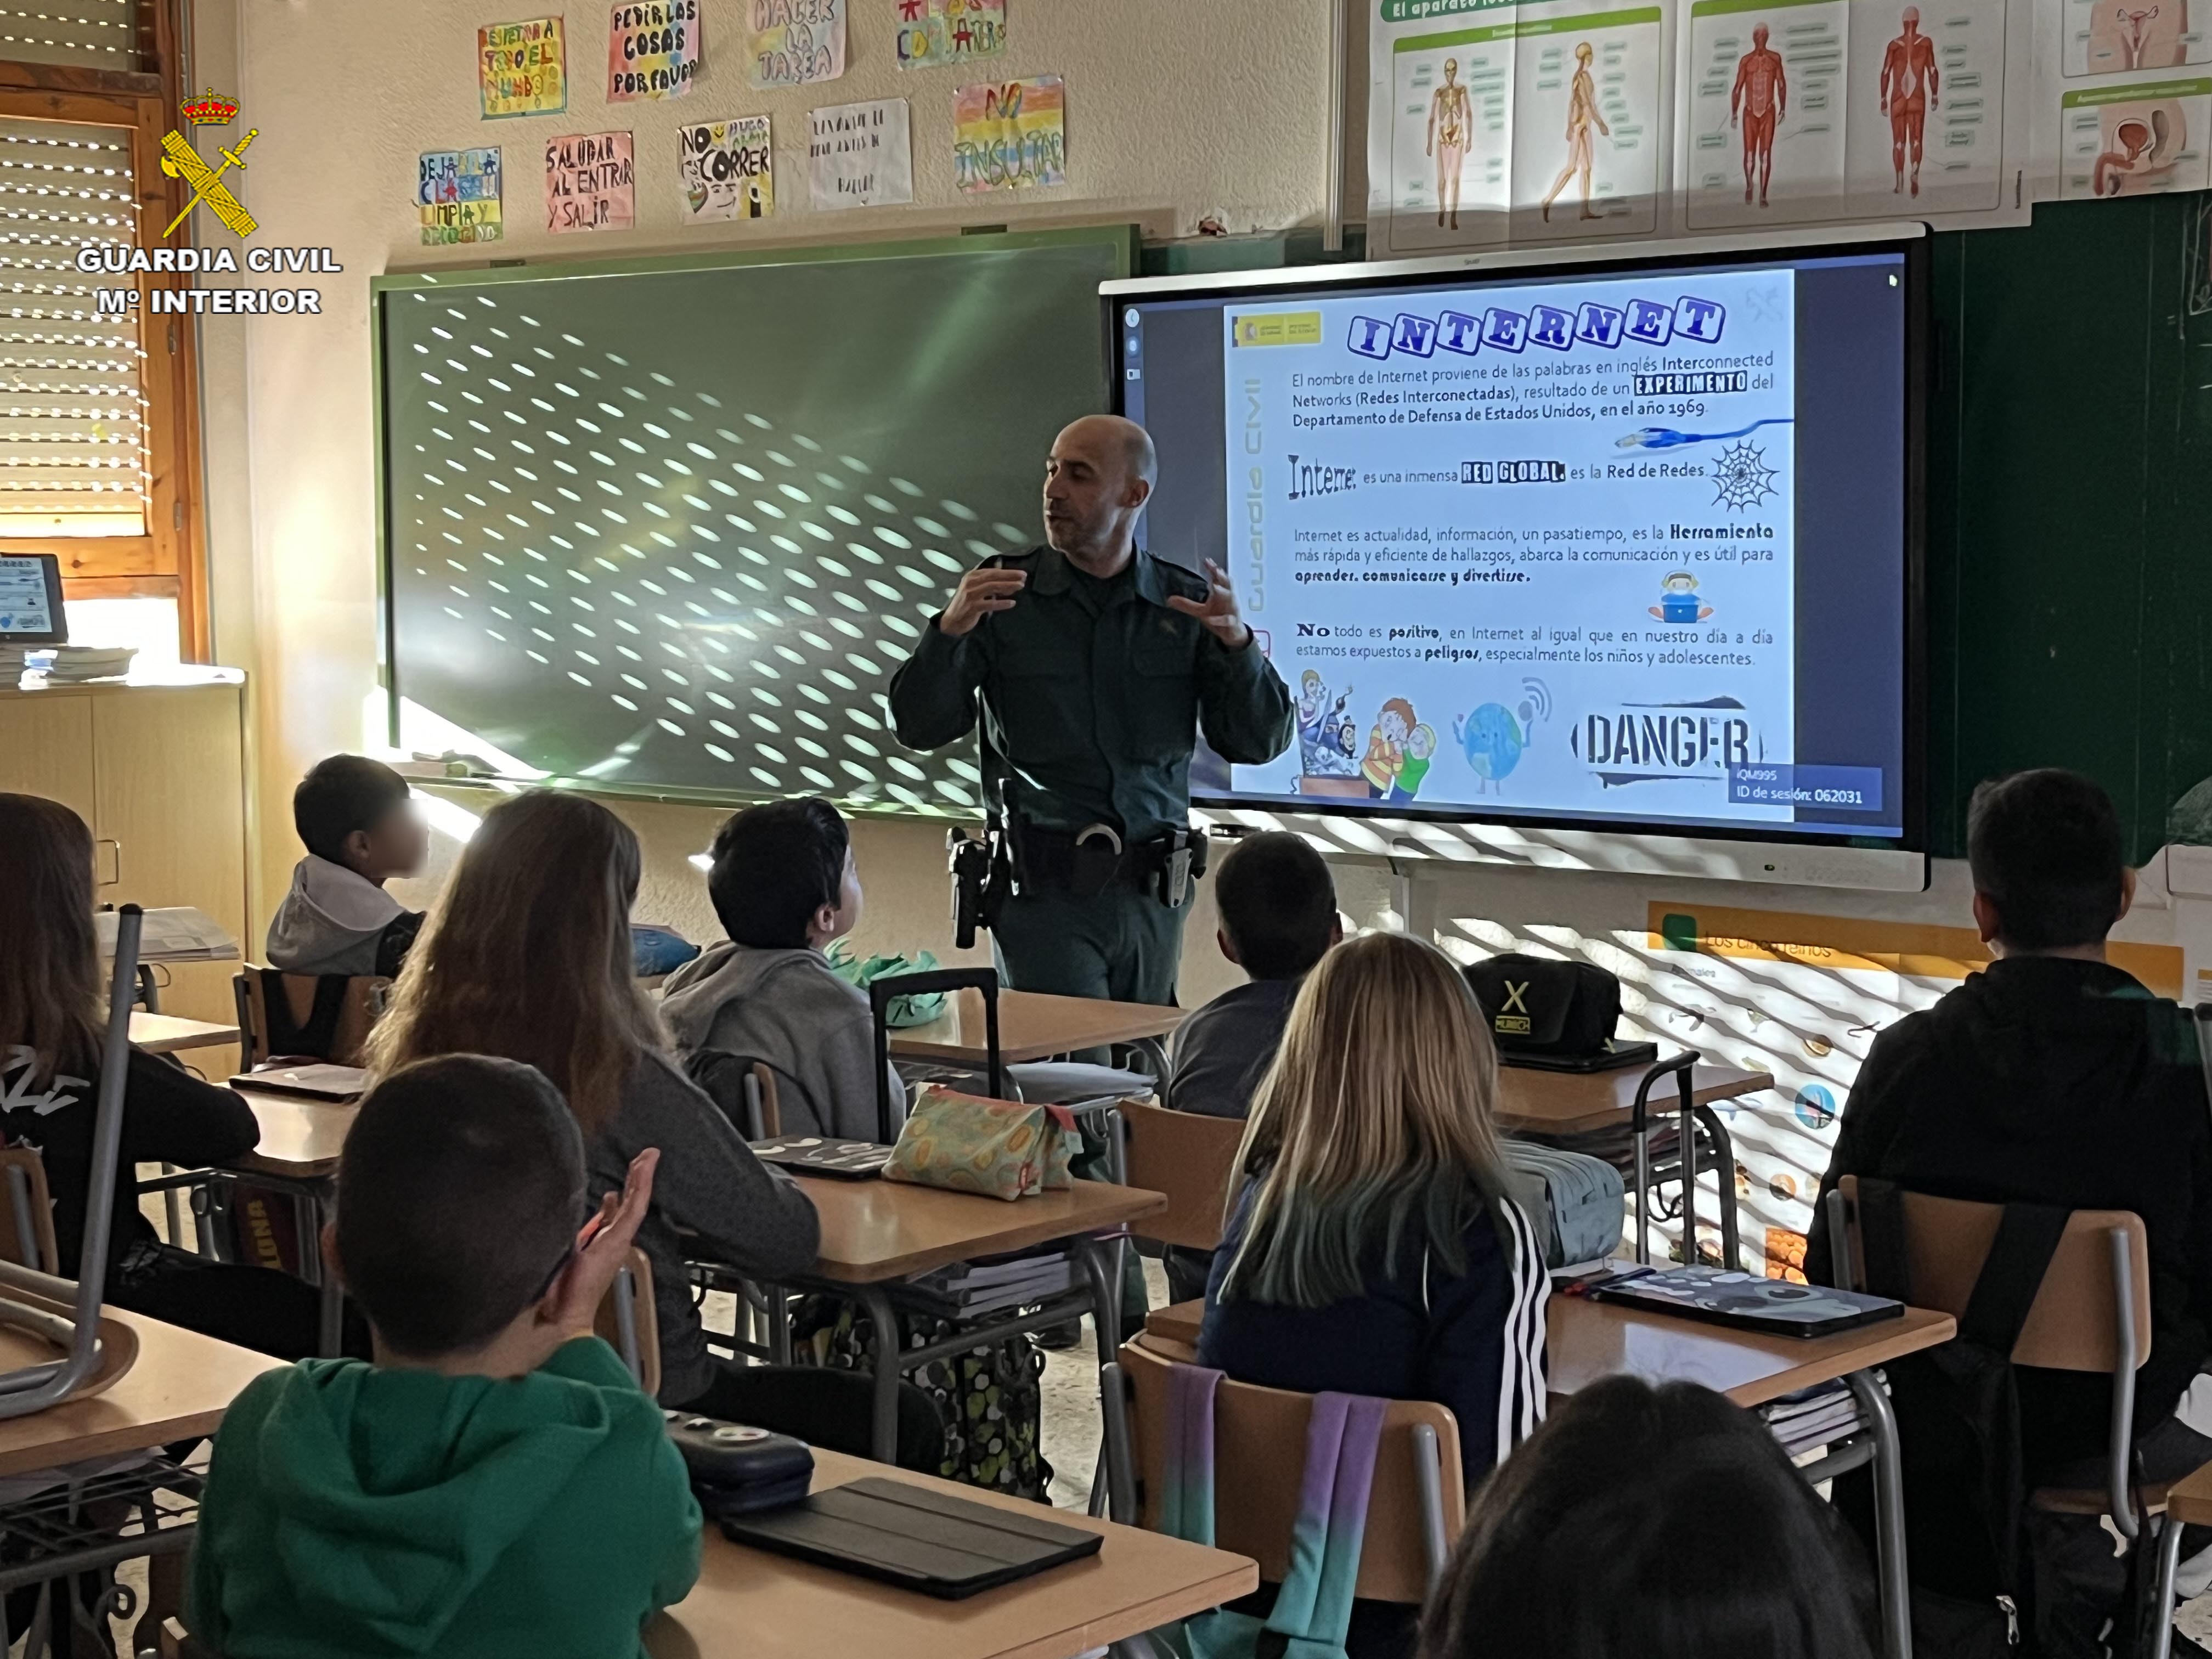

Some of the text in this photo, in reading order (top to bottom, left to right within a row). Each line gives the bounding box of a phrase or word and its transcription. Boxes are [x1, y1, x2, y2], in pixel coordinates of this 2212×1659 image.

[1393, 3, 1406, 17] El
[624, 27, 685, 60] COSAS
[614, 73, 648, 93] POR
[986, 83, 1022, 121] NO
[682, 127, 712, 156] NO
[546, 137, 616, 173] SALUDAR
[698, 146, 769, 182] CORRER
[552, 157, 633, 198] AL ENTRAR
[548, 204, 557, 228] Y
[1355, 298, 1720, 354] INTERNET
[1293, 351, 1774, 387] El nombre de Internet proviene de las palabras en inglés Interconnected
[1293, 372, 1774, 409] Networks (Redes Interconectadas), resultado de un EXPERIMENTO del
[1293, 410, 1386, 430] Departamento
[1390, 410, 1404, 424] de
[1408, 408, 1462, 424] Defensa
[1465, 407, 1481, 422] de
[1485, 405, 1538, 420] Estados
[1542, 404, 1596, 421] Unidos,
[1600, 404, 1618, 416] en
[1622, 401, 1634, 416] el
[1638, 400, 1664, 415] año
[1363, 472, 1376, 483] es
[1380, 471, 1401, 483] una
[1405, 470, 1458, 483] inmensa
[1462, 462, 1493, 484] RED
[1570, 467, 1585, 479] es
[1590, 464, 1602, 479] la
[1607, 462, 1635, 478] Red
[1638, 461, 1657, 477] de
[1295, 523, 1774, 545] Internet es actualidad, información, un pasatiempo, es la Herramienta
[1295, 545, 1774, 566] más rápida y eficiente de hallazgos, abarca la comunicación y es útil para
[1363, 568, 1446, 582] comunicarse
[1451, 572, 1458, 586] y
[1463, 568, 1531, 583] divertirse.
[1296, 623, 1774, 646] No todo es positivo, en Internet al igual que en nuestro día a día
[1296, 645, 1756, 667] estamos expuestos a peligros, especialmente los niños y adolescentes.
[1737, 785, 1863, 804] ID de sesión: 062031
[1706, 932, 1733, 949] Los
